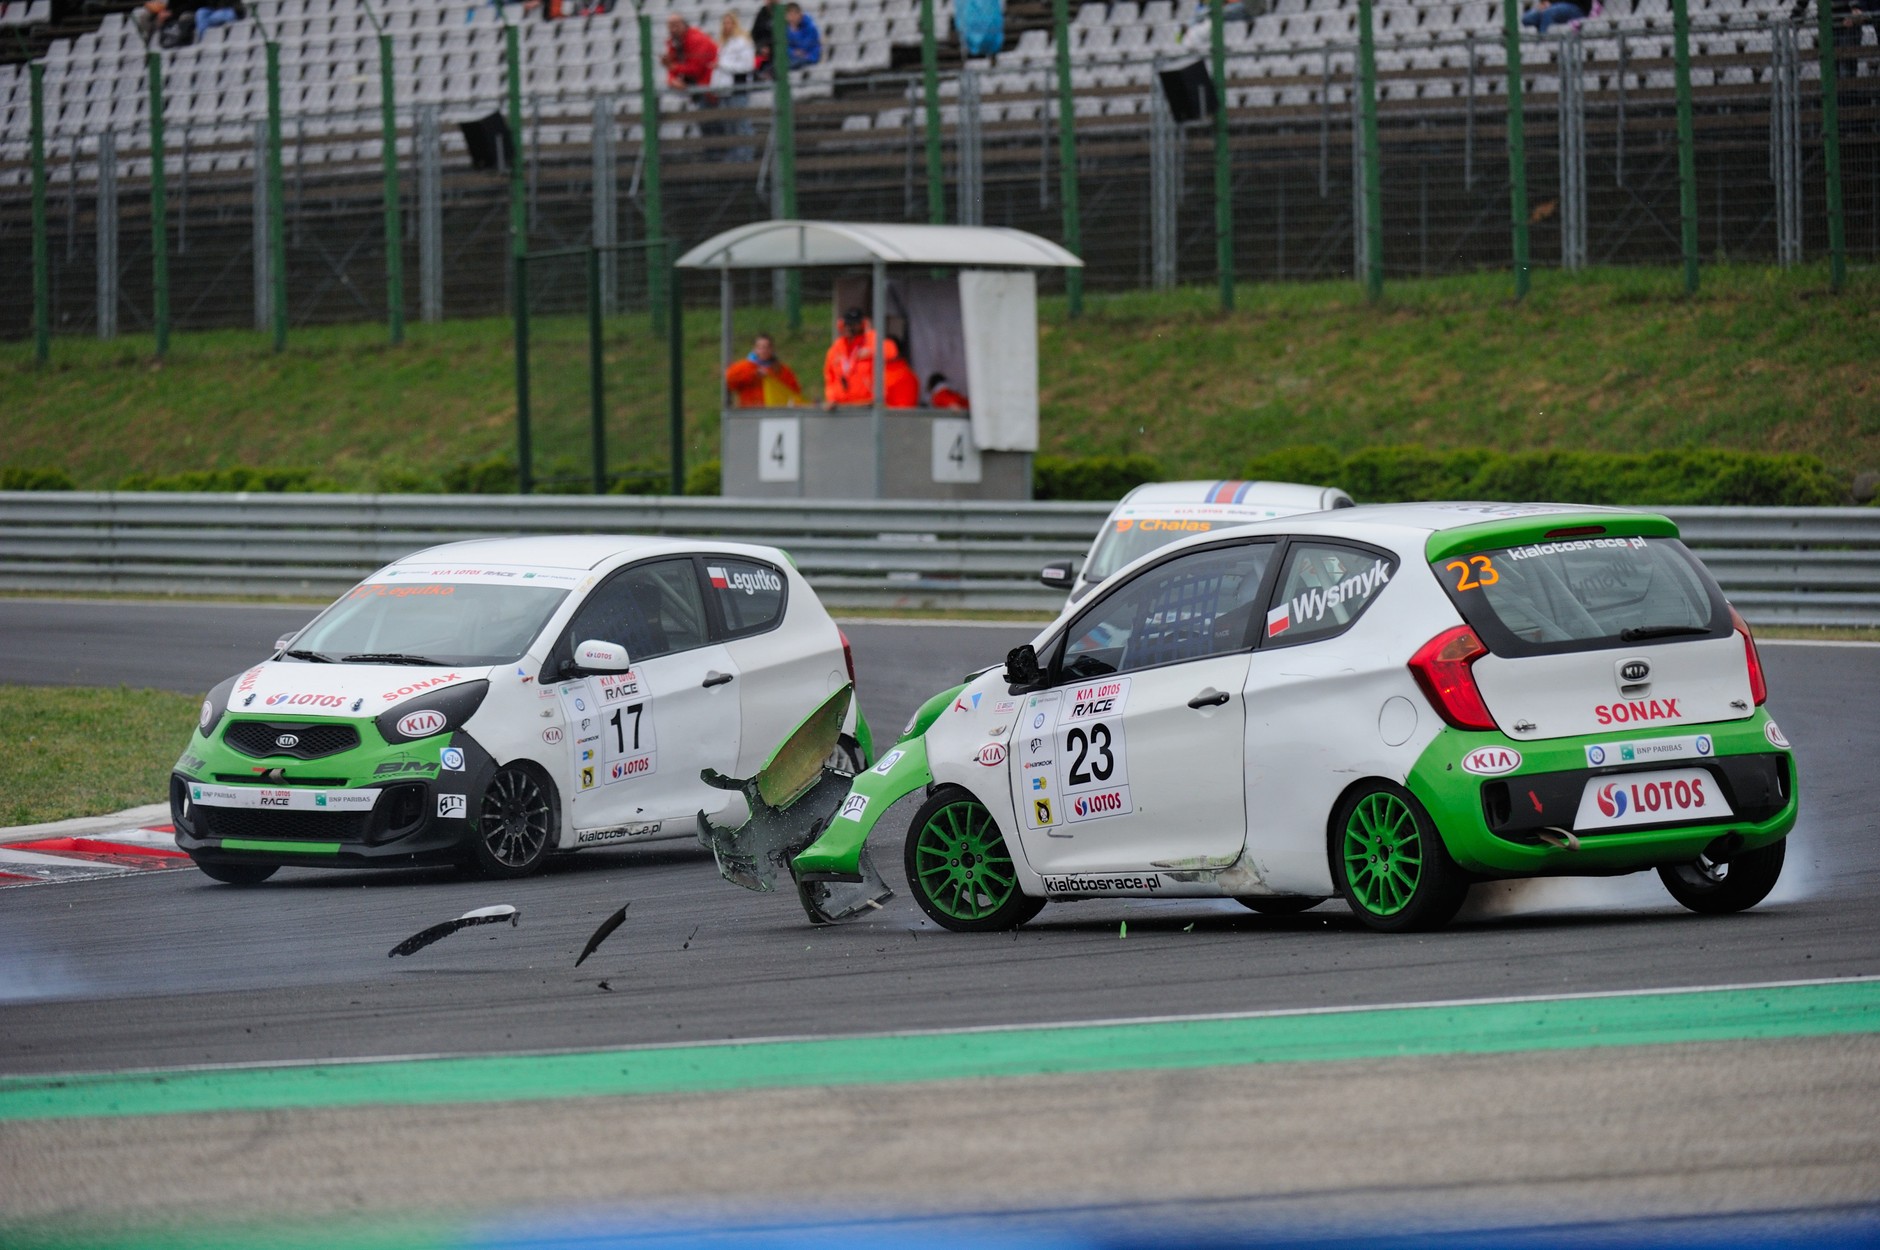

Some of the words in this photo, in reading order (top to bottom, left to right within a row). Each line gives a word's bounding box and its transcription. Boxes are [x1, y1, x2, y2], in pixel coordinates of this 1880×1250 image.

[771, 432, 784, 467] 4
[949, 434, 964, 468] 4
[1115, 519, 1134, 533] 9
[1139, 519, 1213, 532] Chalas
[1506, 535, 1648, 561] kialotosrace.pl
[723, 567, 782, 595] Legutko
[1446, 554, 1500, 592] 23
[378, 584, 456, 599] Legutko
[1291, 559, 1390, 624] Wysmyk
[593, 652, 613, 660] LOTOS
[600, 676, 615, 687] KIA
[618, 671, 636, 683] LOTOS
[1625, 666, 1646, 678] KIA
[382, 673, 462, 701] SONAX
[605, 683, 639, 700] RACE
[1077, 687, 1094, 700] KIA
[1098, 683, 1121, 698] LOTOS
[287, 693, 348, 708] LOTOS
[1072, 698, 1116, 718] RACE
[1595, 698, 1682, 725] SONAX
[406, 715, 439, 732] KIA
[610, 703, 644, 754] 17
[278, 736, 294, 745] KIA
[545, 730, 561, 742] KIA
[982, 747, 1001, 761] KIA
[1066, 722, 1115, 786] 23
[1636, 746, 1652, 755] BNP
[1653, 743, 1683, 753] PARIBAS
[373, 761, 442, 774] BM
[623, 757, 649, 776] LOTOS
[1472, 751, 1513, 770] KIA
[202, 790, 213, 798] BNP
[260, 797, 290, 806] RACE
[275, 789, 291, 797] LOTOS
[1631, 778, 1705, 813] LOTOS
[440, 795, 465, 813] ATT
[843, 795, 867, 812] ATT
[1089, 792, 1121, 813] LOTOS
[578, 821, 662, 843] kialotosre.pl
[1044, 873, 1161, 892] kialotosrace.pl
